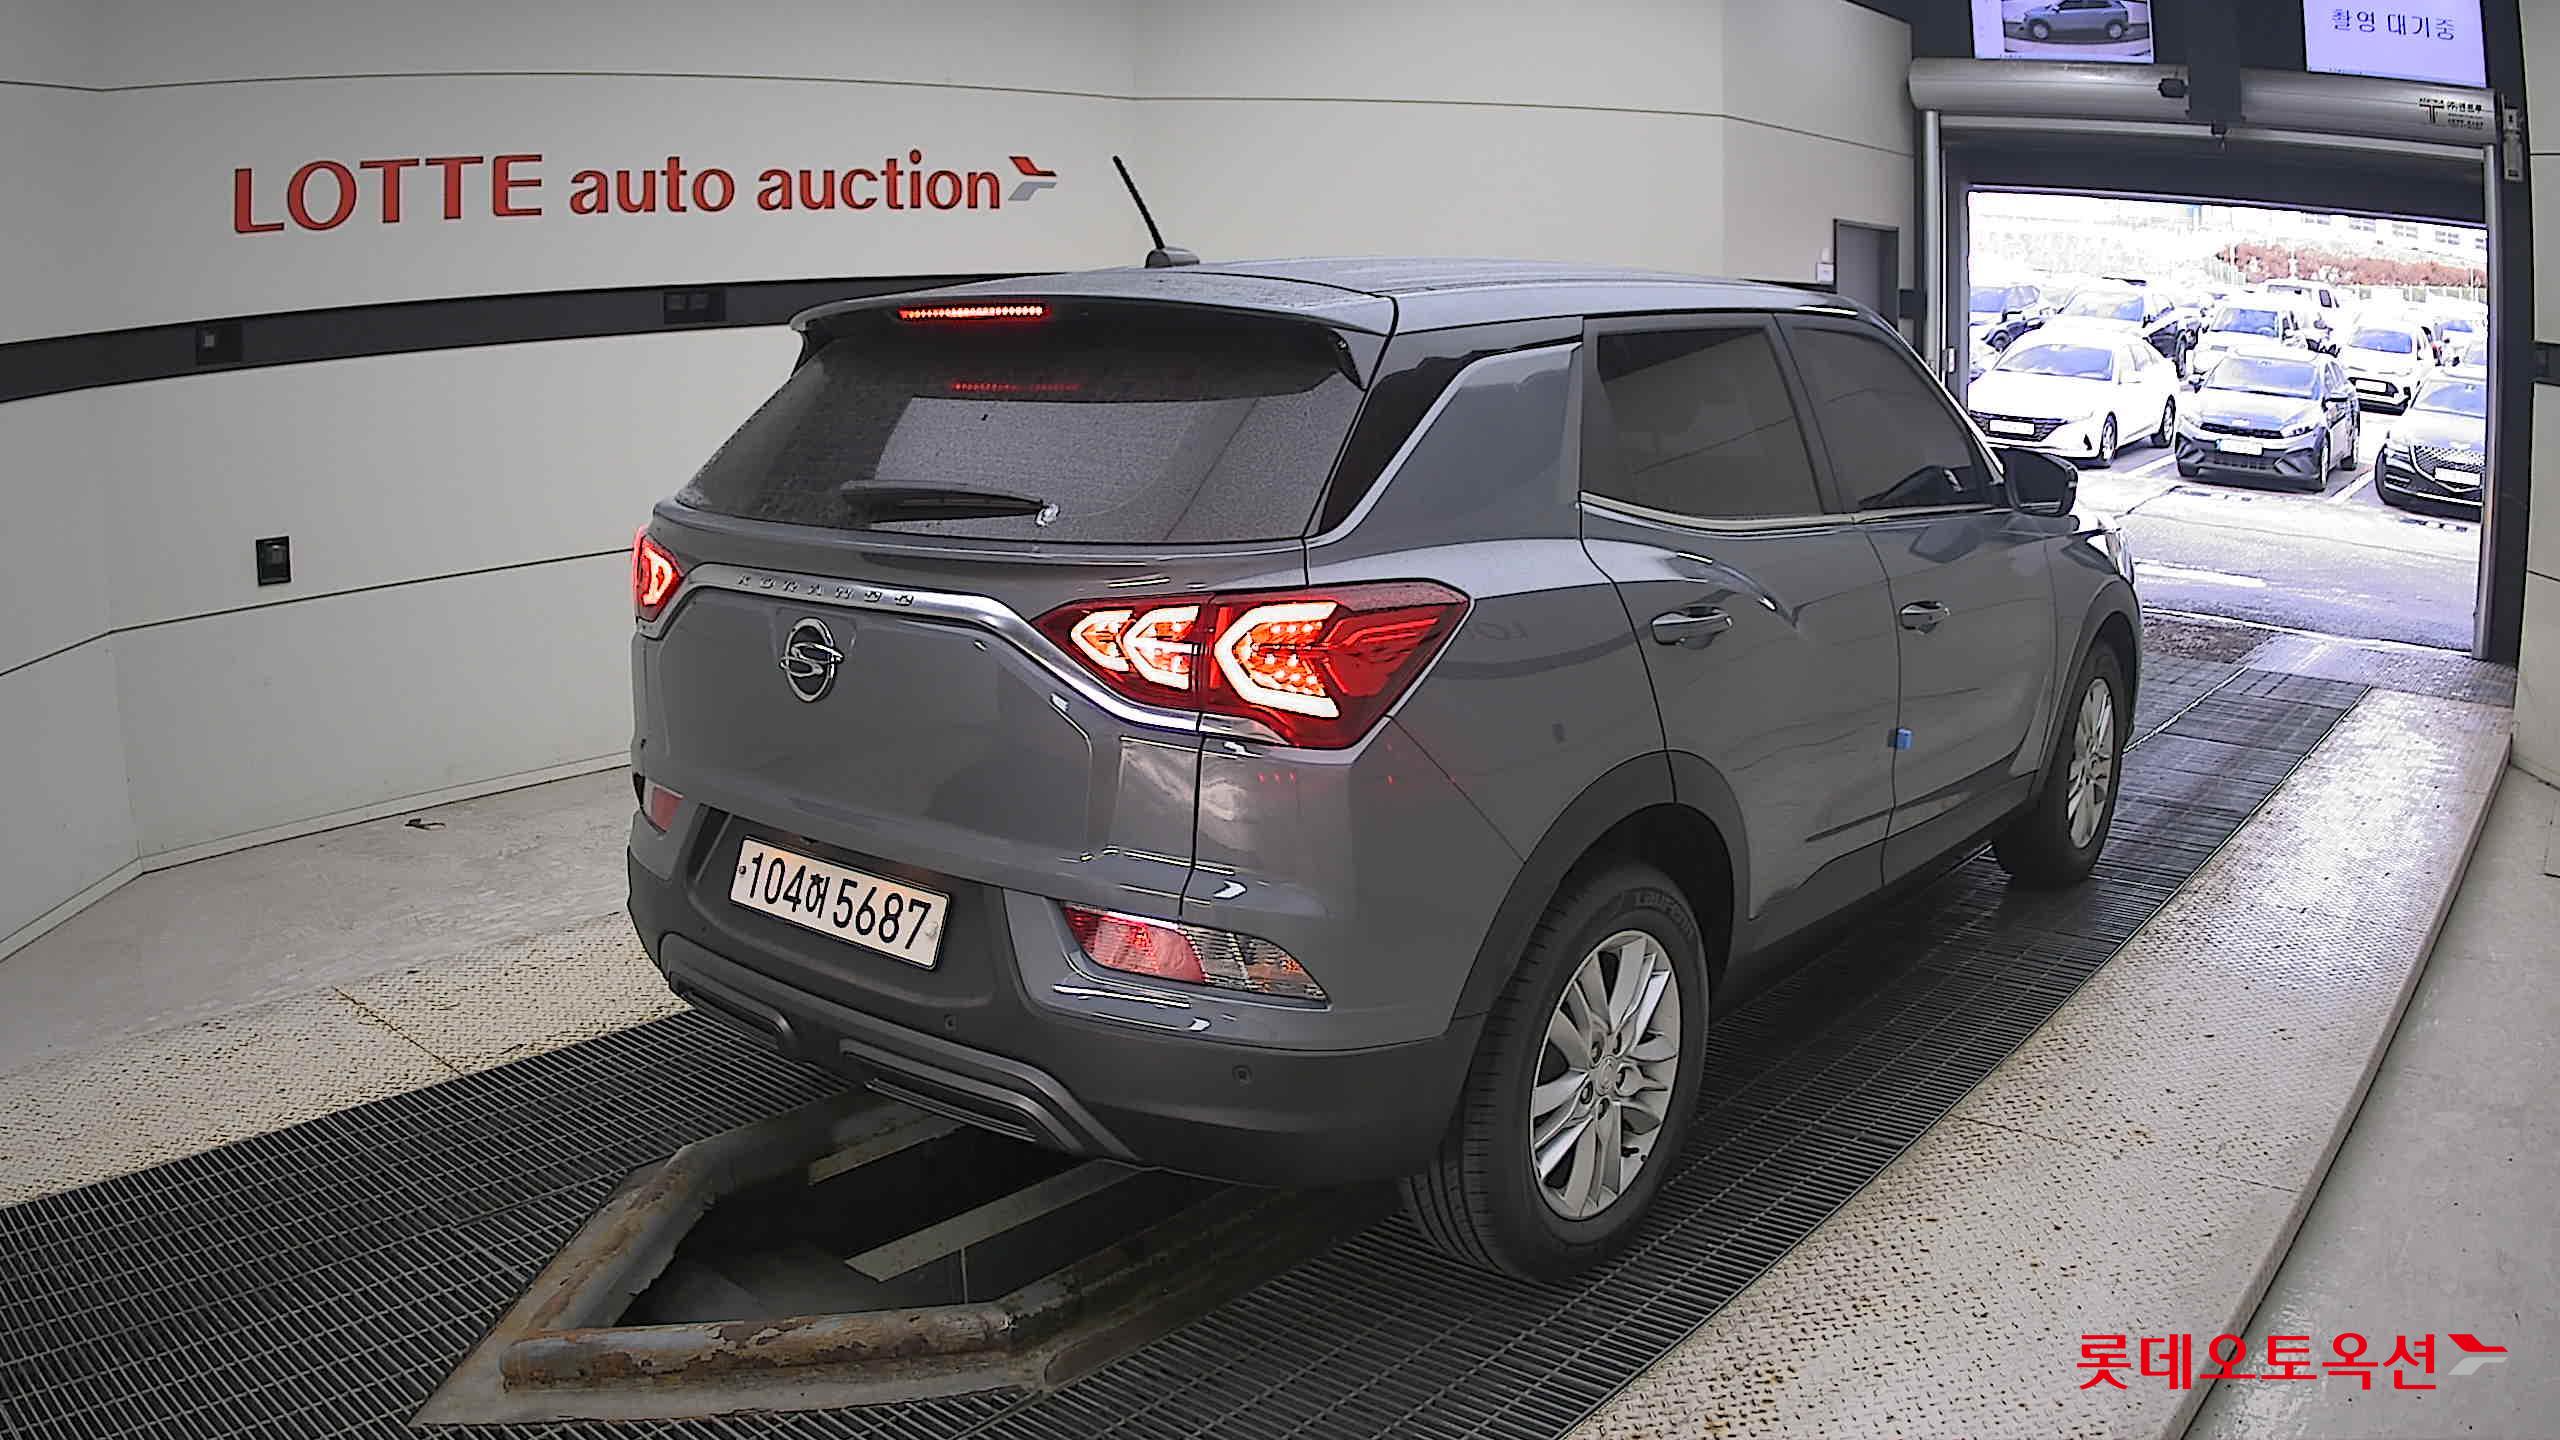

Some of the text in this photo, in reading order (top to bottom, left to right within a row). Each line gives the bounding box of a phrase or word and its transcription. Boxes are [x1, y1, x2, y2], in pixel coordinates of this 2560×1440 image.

[2332, 8, 2376, 33] 촬영
[234, 149, 1003, 234] LOTTE auto auction
[738, 574, 914, 607] KORANDO
